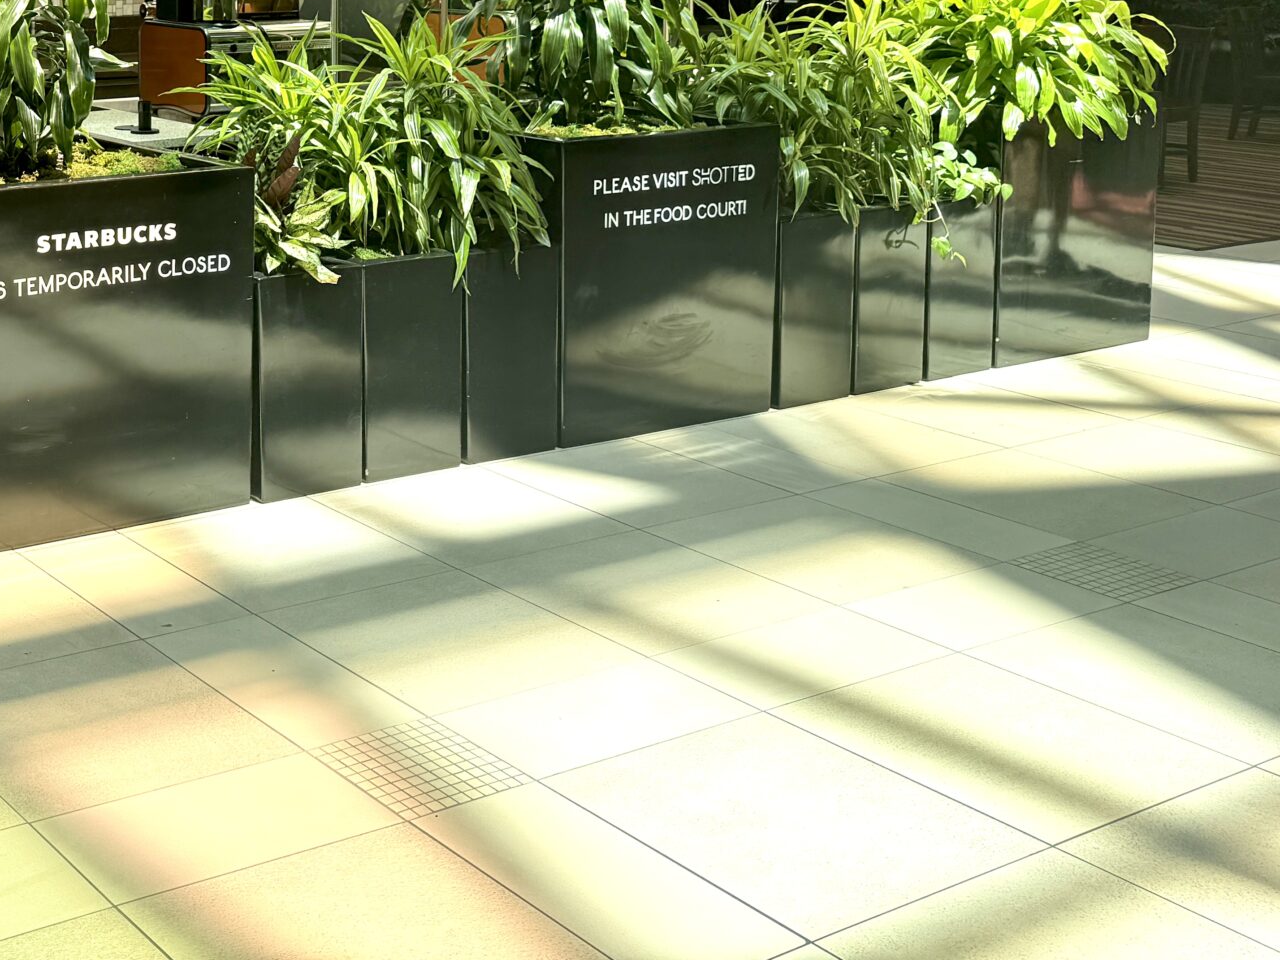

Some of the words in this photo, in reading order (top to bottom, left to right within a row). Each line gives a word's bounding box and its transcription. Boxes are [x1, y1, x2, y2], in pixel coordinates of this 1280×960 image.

[593, 174, 651, 196] PLEASE
[652, 170, 689, 189] VISIT
[691, 163, 756, 187] SHOTTED
[603, 211, 619, 229] IN
[623, 208, 652, 227] THE
[653, 204, 693, 224] FOOD
[696, 199, 747, 220] COURT!
[36, 222, 177, 254] STARBUCKS
[13, 261, 152, 297] TEMPORARILY
[157, 253, 231, 279] CLOSED
